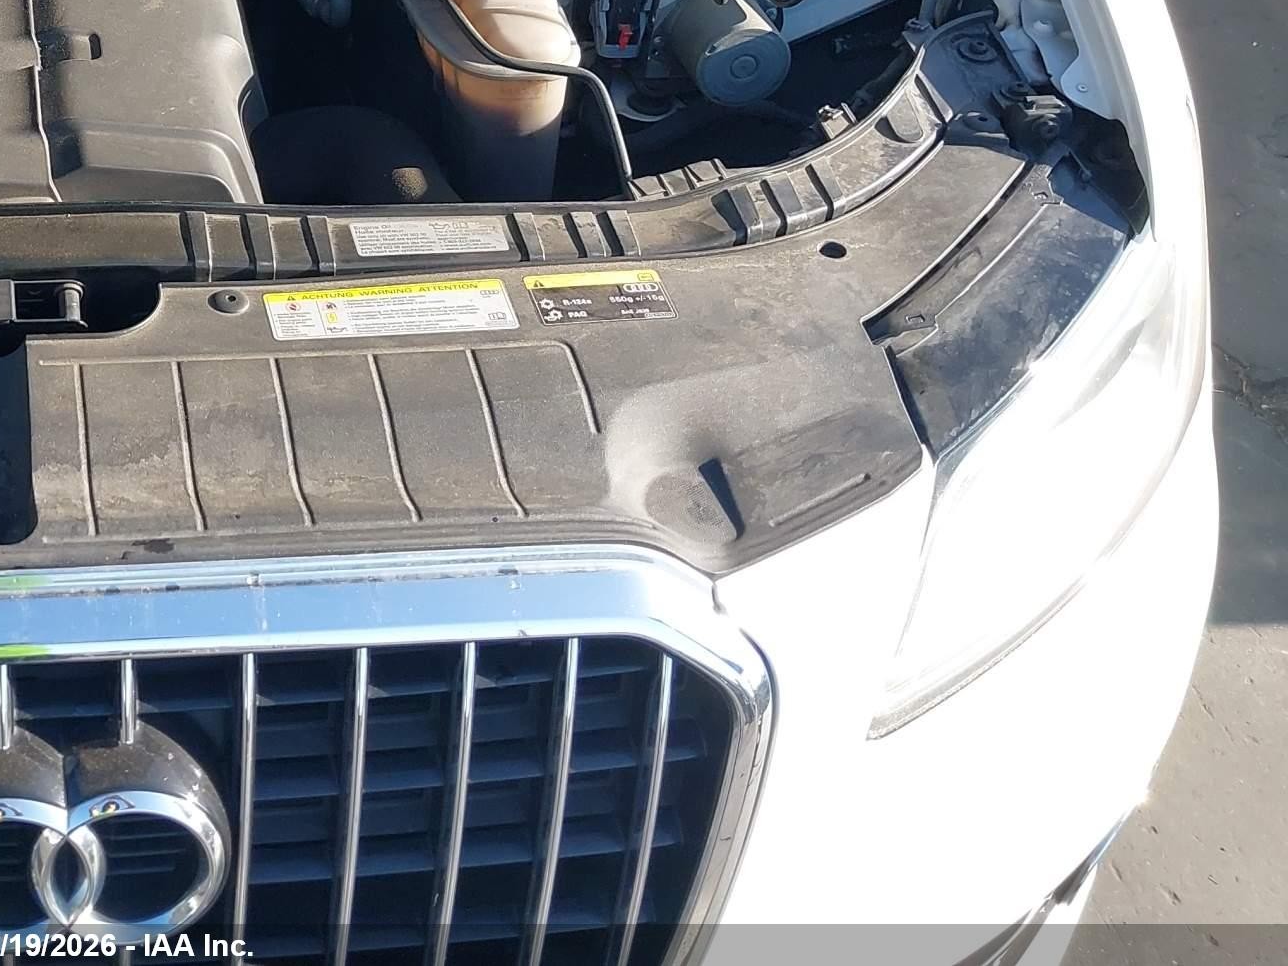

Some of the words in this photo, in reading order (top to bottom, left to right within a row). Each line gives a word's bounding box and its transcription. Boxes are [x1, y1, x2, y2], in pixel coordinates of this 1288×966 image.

[301, 291, 354, 301] ACHTUNG
[359, 287, 412, 297] WARNING
[417, 283, 478, 292] ATTENTION
